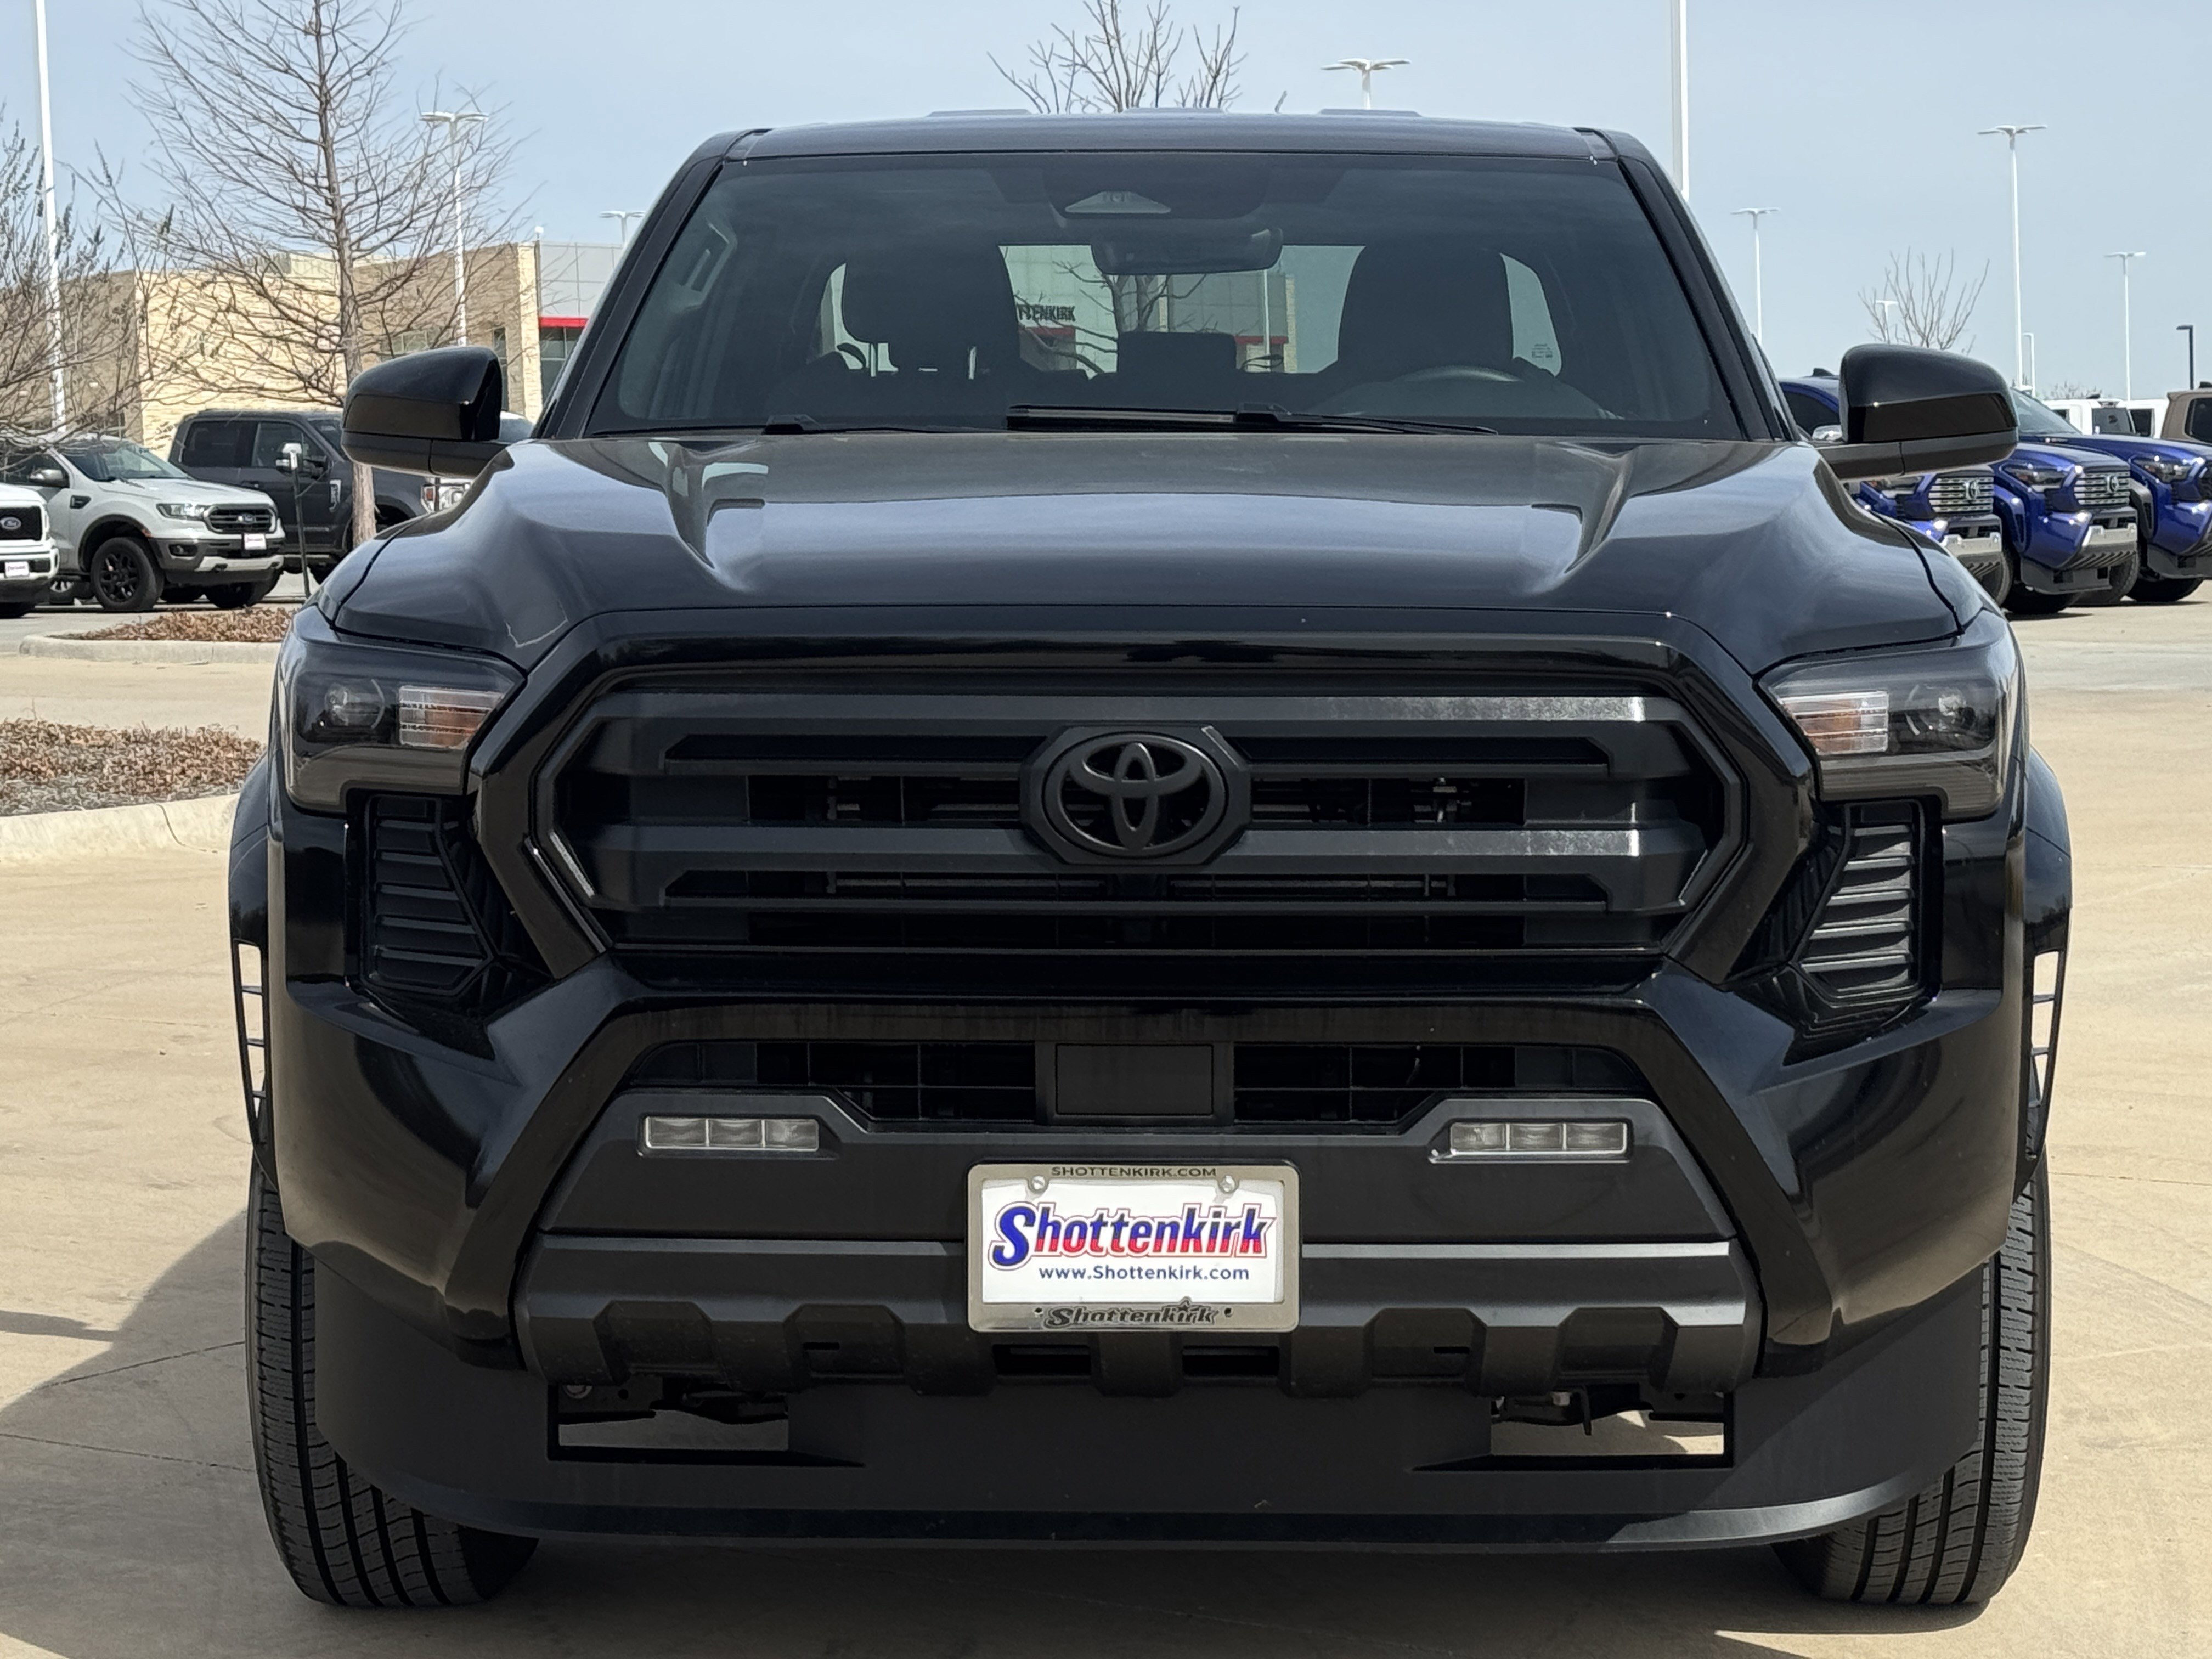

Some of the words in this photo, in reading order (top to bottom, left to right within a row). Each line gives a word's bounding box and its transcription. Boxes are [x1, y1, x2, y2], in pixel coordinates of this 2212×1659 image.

[1051, 1166, 1217, 1177] SHOTTENKIRK.COM
[991, 1205, 1269, 1268] Shottenkirk
[1039, 1265, 1250, 1280] www.Shottenkirk.com
[1044, 1305, 1218, 1328] Shottenkirk
